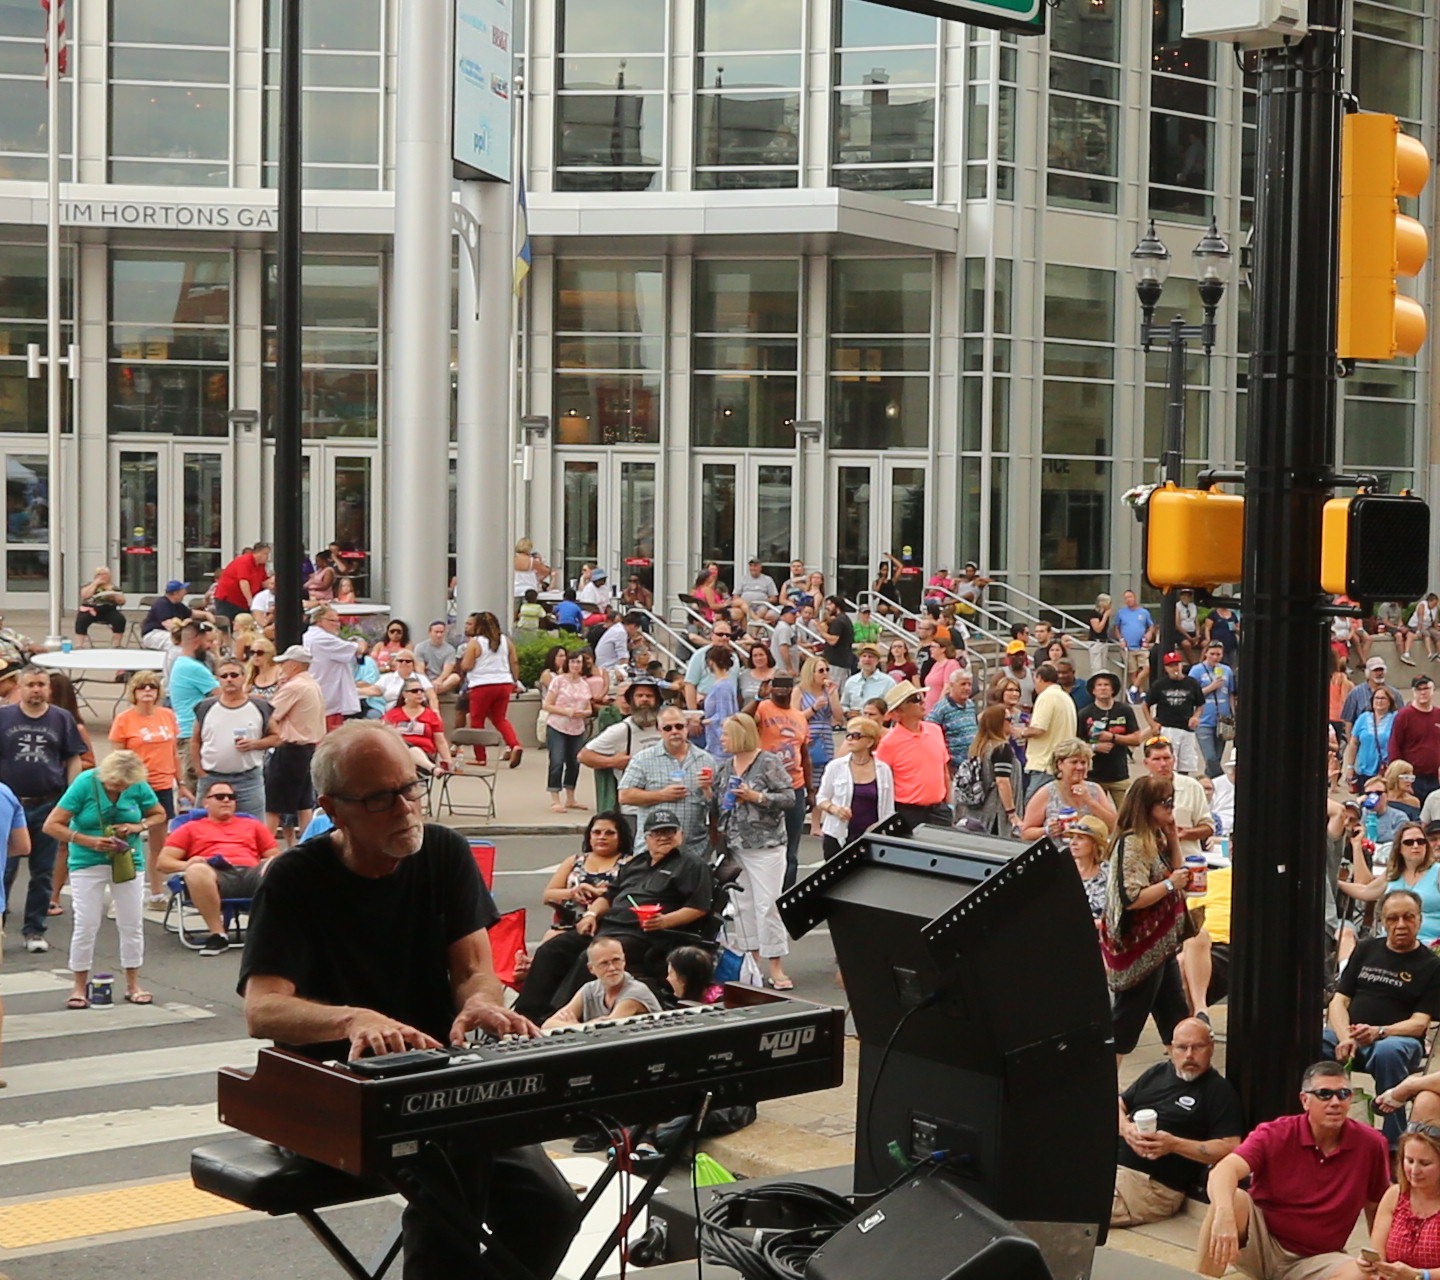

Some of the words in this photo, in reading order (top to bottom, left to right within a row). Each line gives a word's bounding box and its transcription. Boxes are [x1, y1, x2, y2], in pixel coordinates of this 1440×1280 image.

[101, 207, 229, 226] HORTONS
[759, 1026, 817, 1059] MOJO
[405, 1077, 545, 1114] CRUMAR
